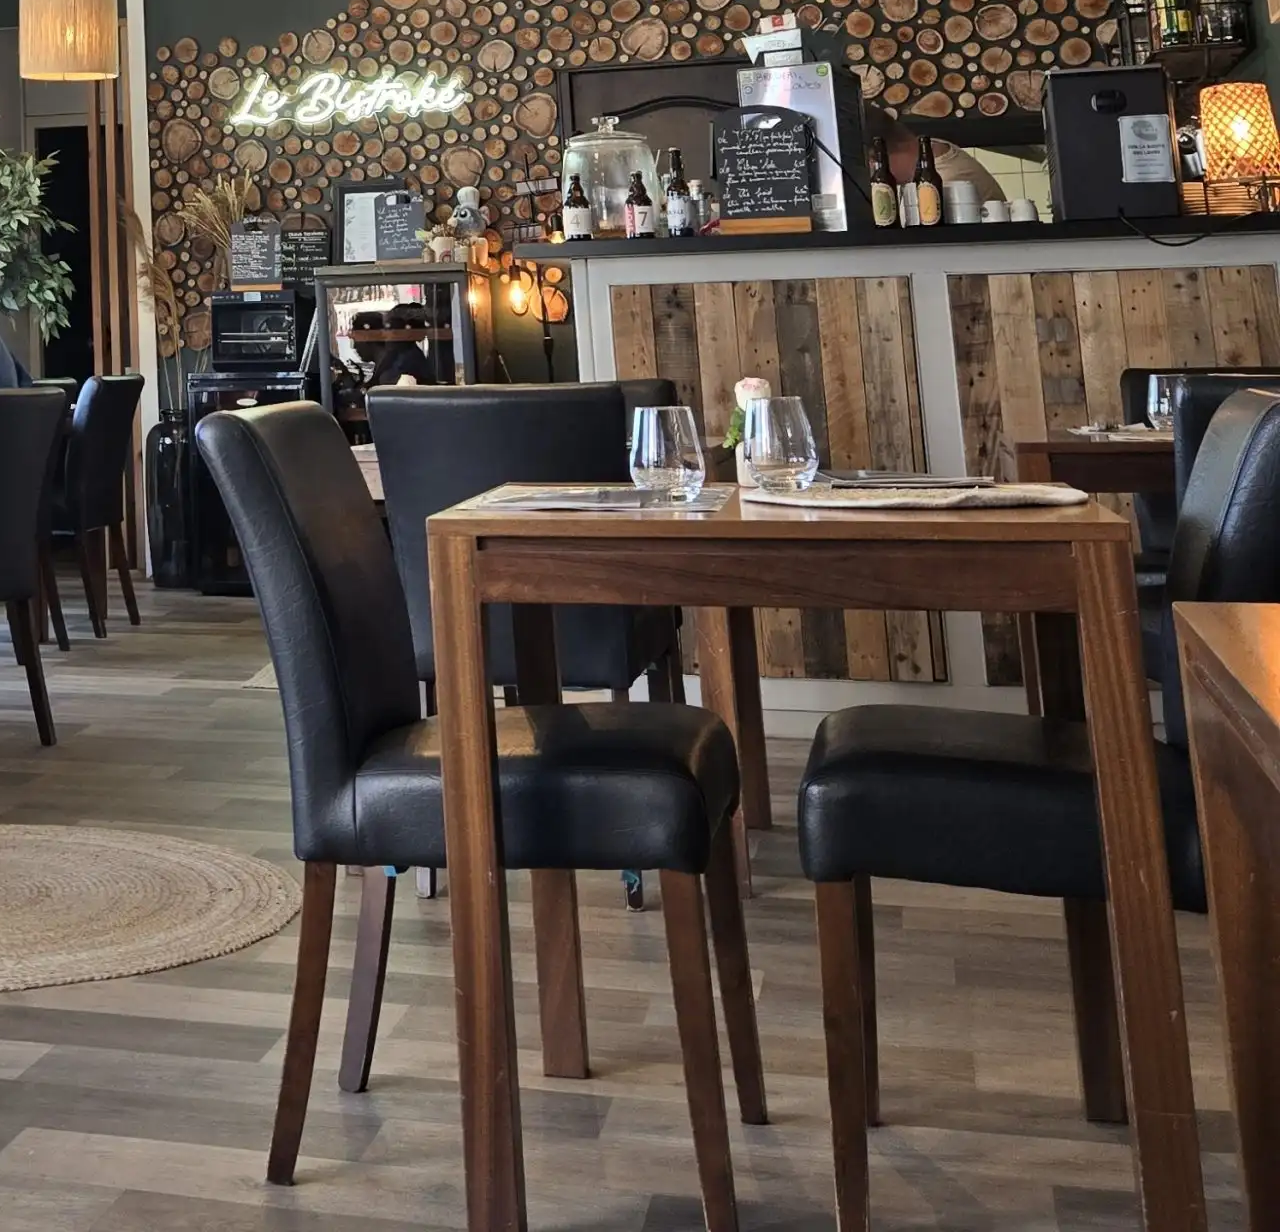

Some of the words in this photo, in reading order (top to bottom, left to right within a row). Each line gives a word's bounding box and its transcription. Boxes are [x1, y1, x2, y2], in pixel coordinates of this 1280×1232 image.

[229, 71, 287, 124] Le
[570, 213, 581, 229] 4
[637, 211, 648, 227] 7
